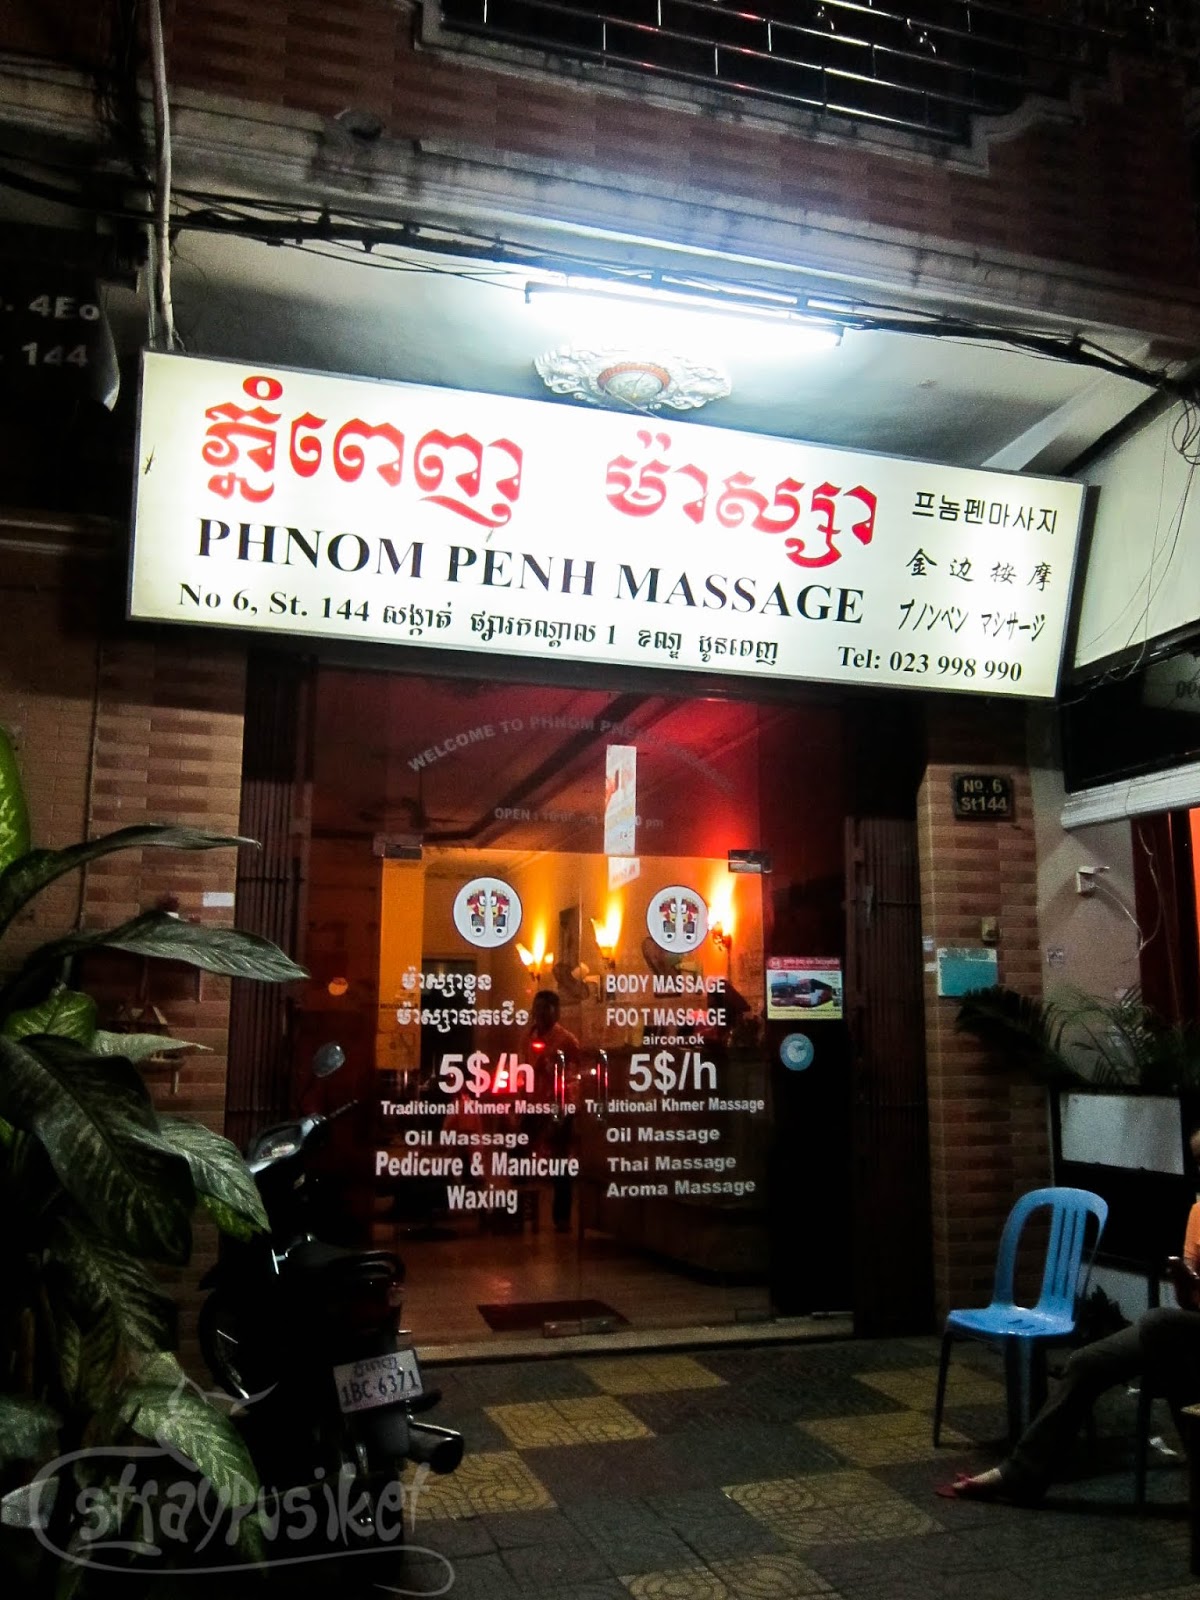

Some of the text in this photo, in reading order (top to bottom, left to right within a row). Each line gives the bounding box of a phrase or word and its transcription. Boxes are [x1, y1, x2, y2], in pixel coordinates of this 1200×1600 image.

[21, 341, 89, 368] 144
[911, 491, 1059, 535] 프놈펜마사지
[197, 517, 866, 625] PHNOM PENH MASSAGE
[178, 582, 222, 609] No
[232, 588, 259, 616] 6,
[268, 591, 308, 617] St.
[320, 596, 370, 622] 144
[605, 624, 616, 645] 1
[838, 645, 1024, 682] Tel: 023 998 990
[407, 724, 497, 772] WELCOME
[499, 718, 525, 735] TO
[991, 778, 1004, 795] 6
[493, 807, 531, 821] OPEN
[605, 974, 727, 994] BODY MASSAGE
[653, 1007, 727, 1027] MASSAGE
[642, 1032, 705, 1046] aircon.ok
[437, 1050, 535, 1098] 5$/h
[628, 1050, 718, 1095] 5$/h
[380, 1100, 459, 1116] Traditional
[463, 1100, 511, 1115] Khmer
[661, 1098, 705, 1113] Khmer
[708, 1097, 765, 1114] Massage
[404, 1130, 529, 1149] Oil Massage
[605, 1126, 721, 1144] Oil Massage
[375, 1151, 580, 1177] Pedicure & Manicure
[606, 1155, 737, 1174] Thai Massage
[606, 1179, 756, 1198] Aroma Massage
[446, 1184, 519, 1215] Waxing
